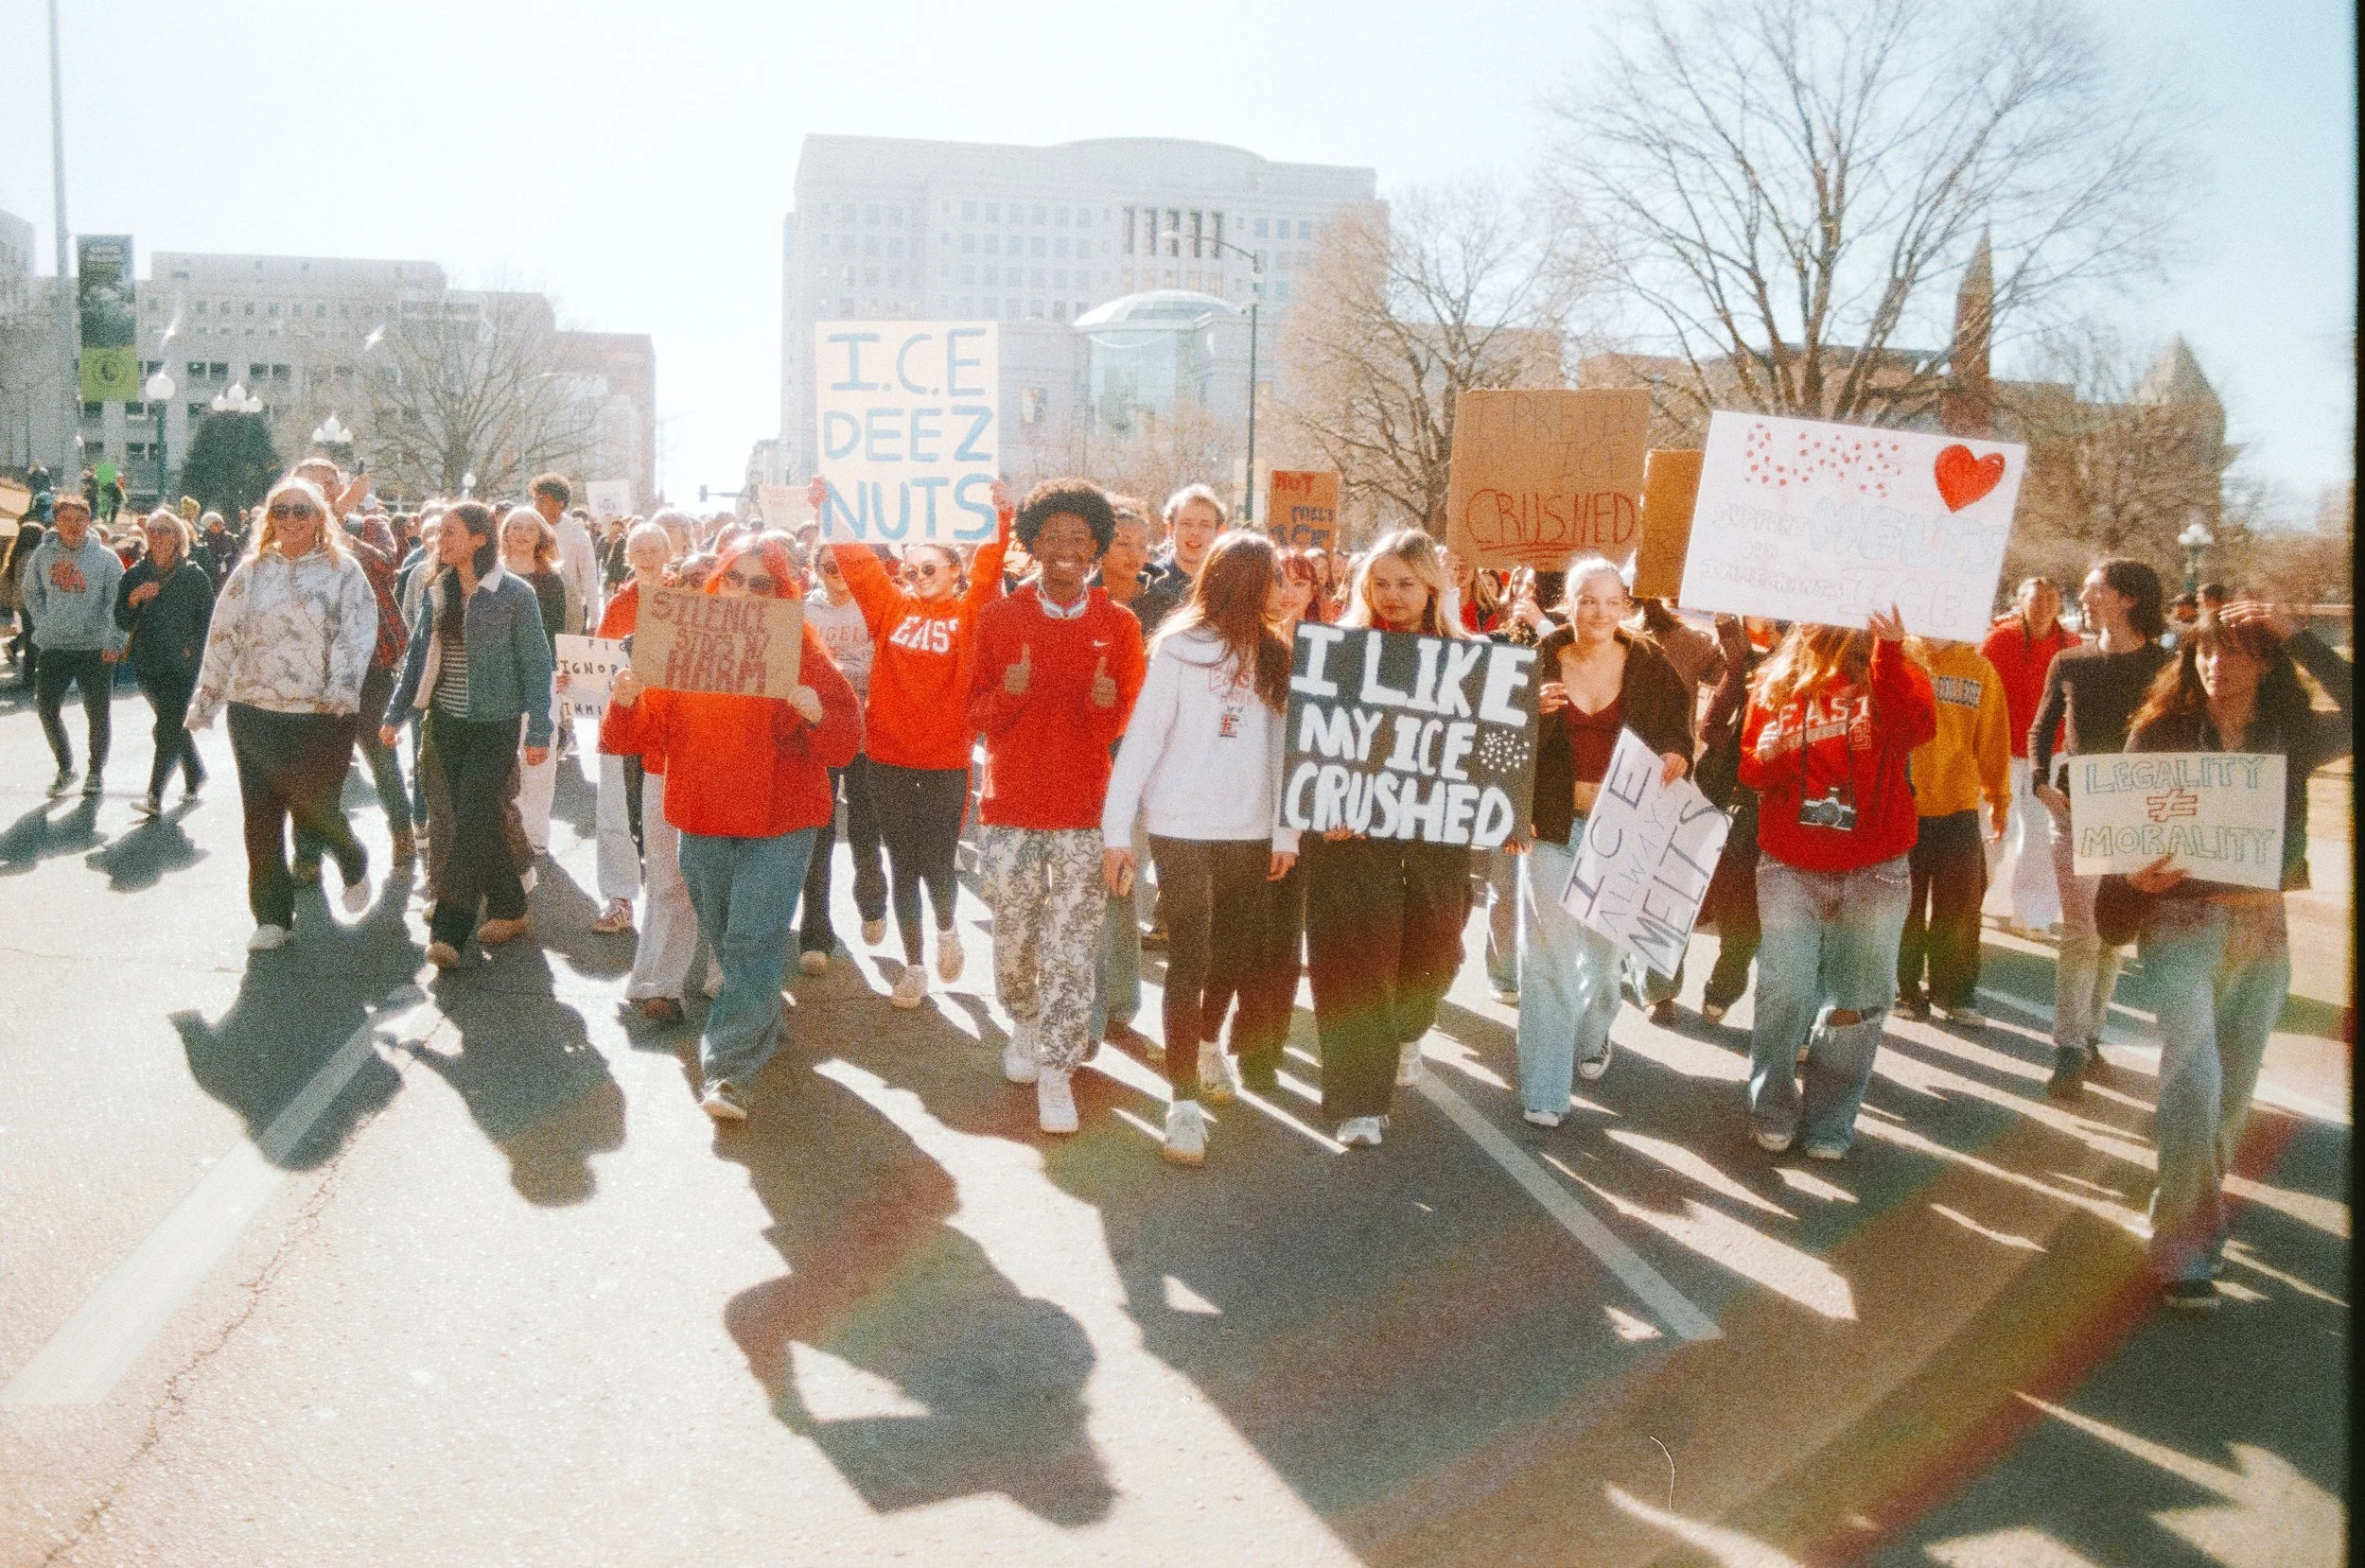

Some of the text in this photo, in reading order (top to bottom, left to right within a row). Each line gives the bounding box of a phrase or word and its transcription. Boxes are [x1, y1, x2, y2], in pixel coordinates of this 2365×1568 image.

[827, 328, 987, 397] I.C.E
[823, 405, 993, 462] DEEZ
[821, 473, 997, 541] NUTS
[1466, 488, 1636, 546] CRUSHED
[1811, 497, 2006, 575] MELTS
[588, 639, 628, 653] FIG
[651, 591, 769, 634] SILENCE
[665, 650, 767, 694] HARM
[1290, 623, 1537, 727] I LIKE
[1299, 704, 1478, 781] MY ICE
[2085, 756, 2267, 794] LEGALITY
[1284, 761, 1515, 847] CRUSHED
[1563, 748, 1652, 919] ICE
[2080, 824, 2278, 865] MORALITY
[1628, 799, 1730, 977] MELTS
